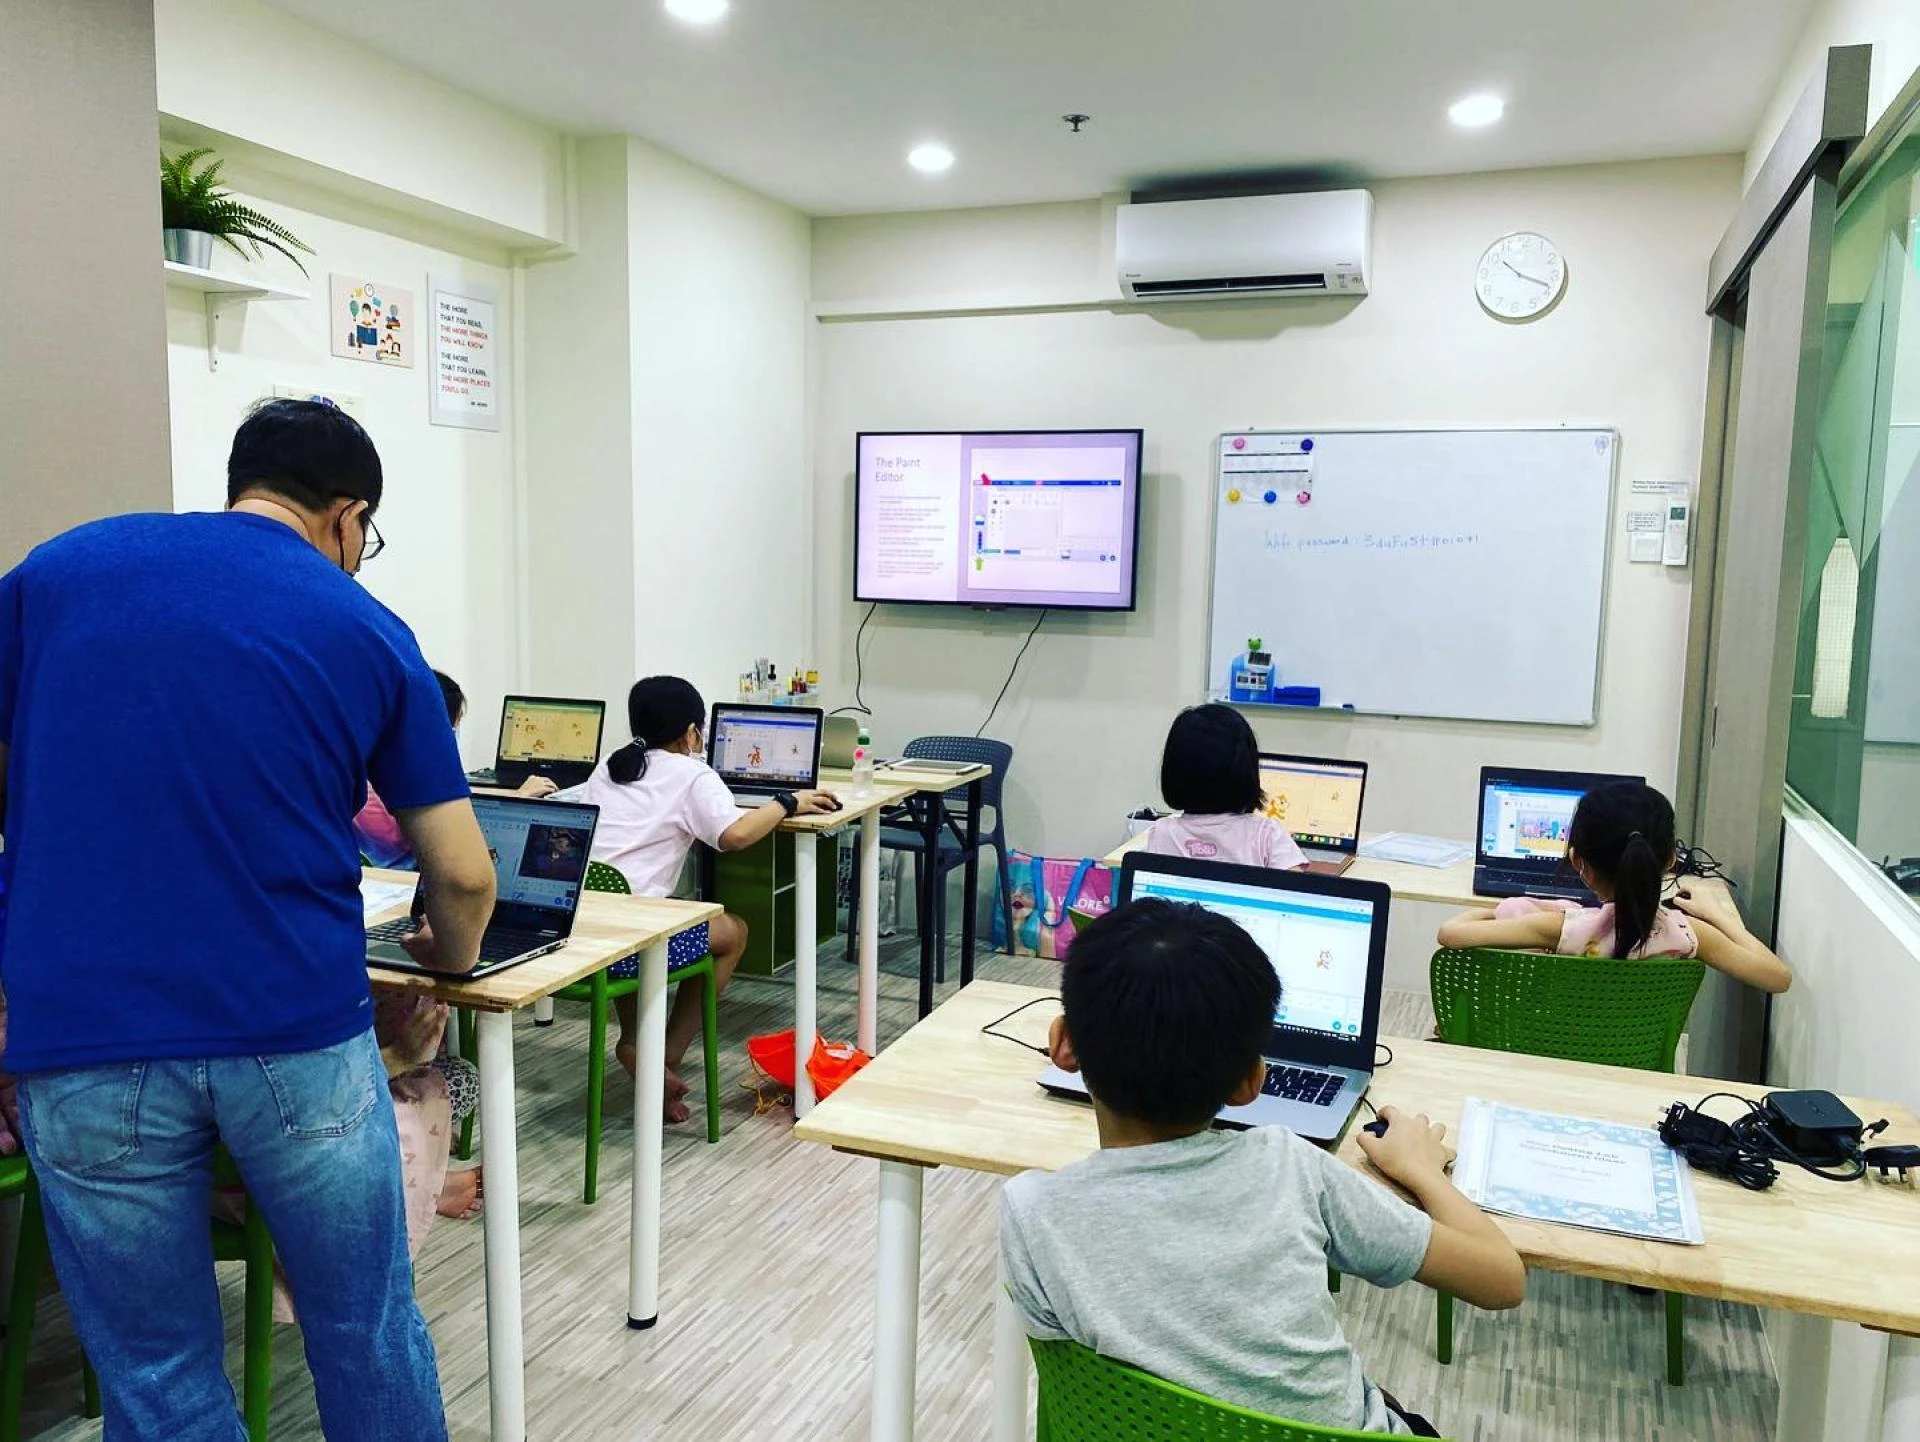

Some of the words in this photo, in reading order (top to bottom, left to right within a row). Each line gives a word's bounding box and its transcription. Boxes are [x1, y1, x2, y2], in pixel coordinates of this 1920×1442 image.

[875, 456, 894, 468] The
[895, 456, 921, 468] Paint
[875, 471, 905, 482] Editor
